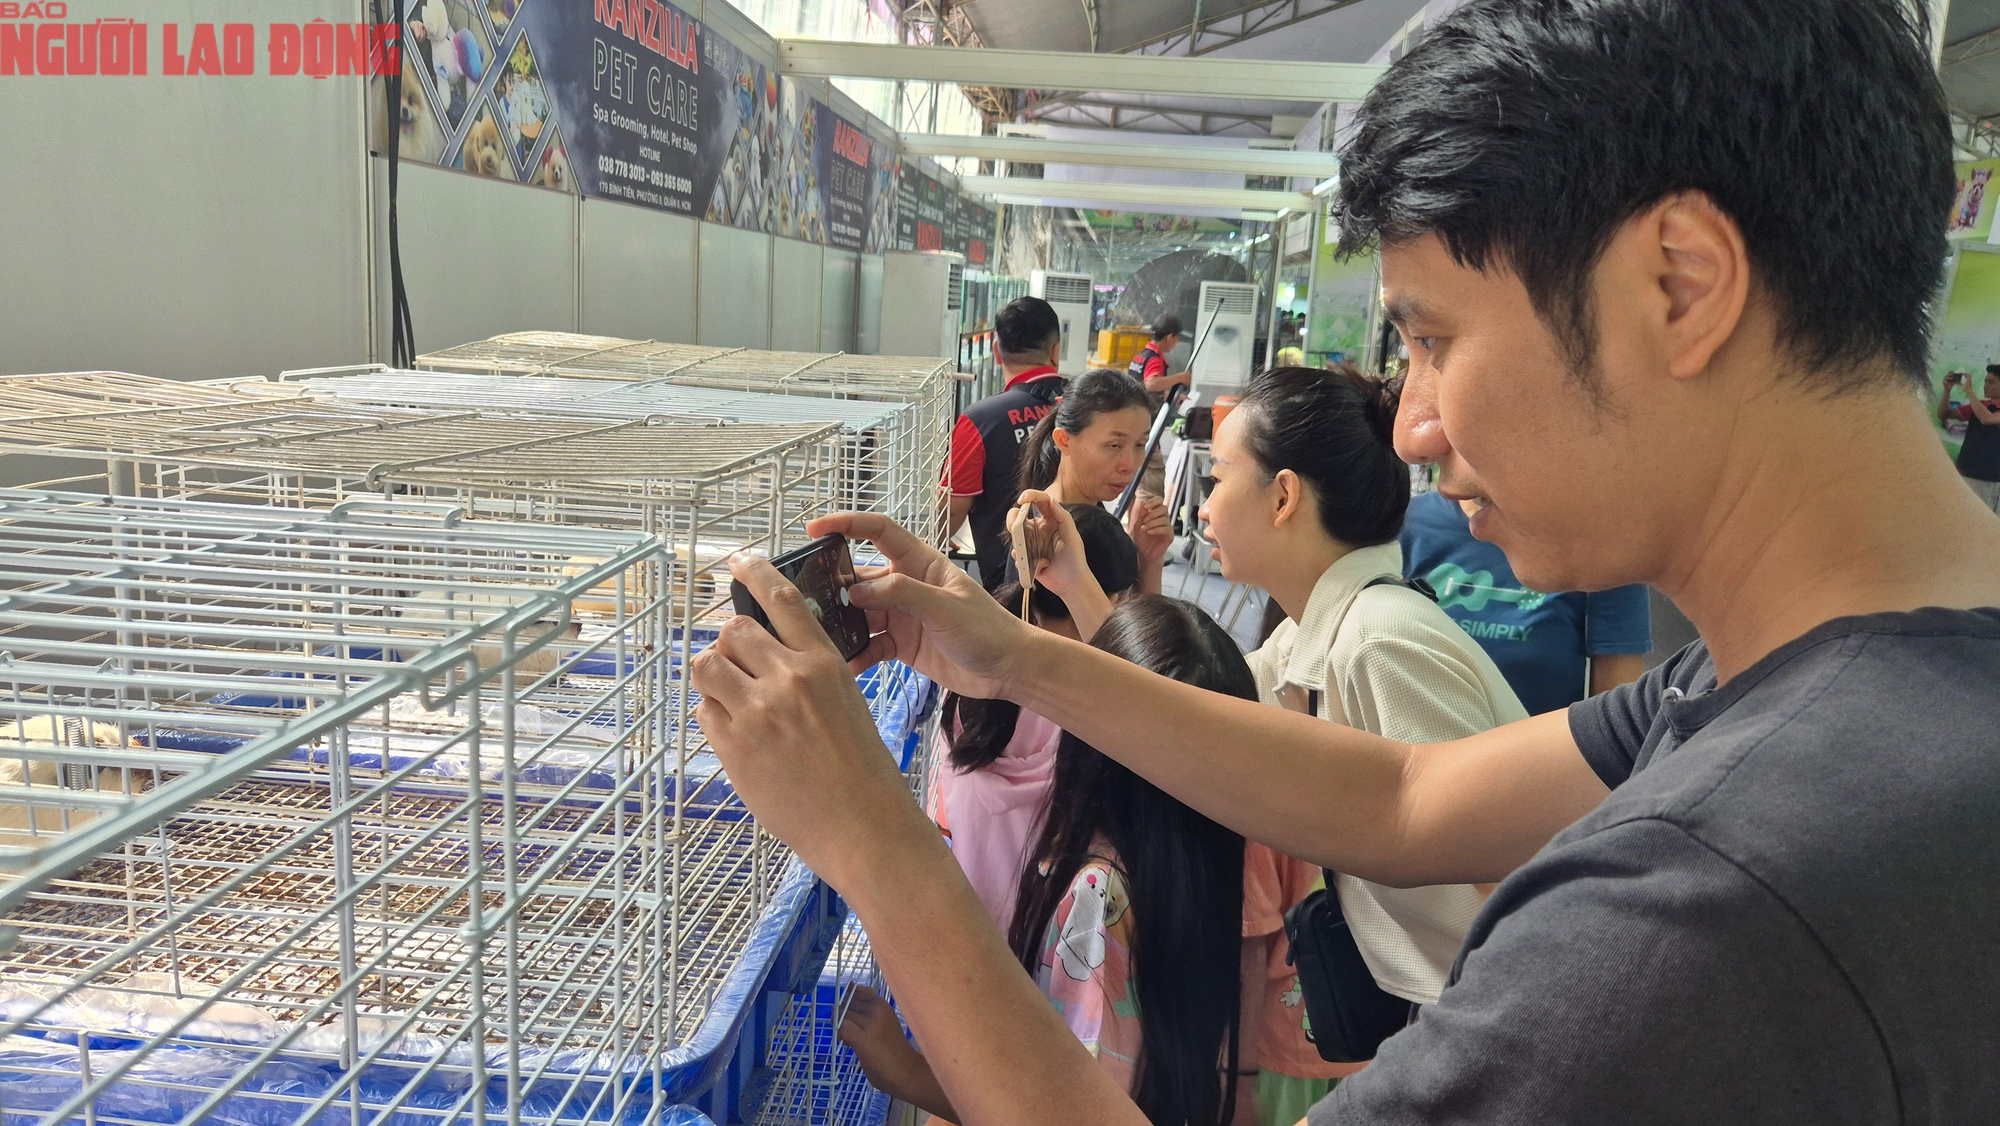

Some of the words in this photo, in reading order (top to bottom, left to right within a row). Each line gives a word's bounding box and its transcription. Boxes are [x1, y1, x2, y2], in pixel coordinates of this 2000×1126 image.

[593, 37, 638, 105] PET
[646, 66, 698, 131] CARE
[593, 103, 608, 123] Spa
[610, 109, 649, 139] Grooming,
[651, 124, 670, 147] Hotel,
[671, 132, 682, 149] Pet
[682, 137, 697, 156] Shop
[639, 145, 661, 162] HOTLINE
[598, 155, 614, 174] 038
[615, 159, 628, 178] 778
[629, 163, 645, 182] 3013
[1460, 619, 1534, 641] SIMPLY
